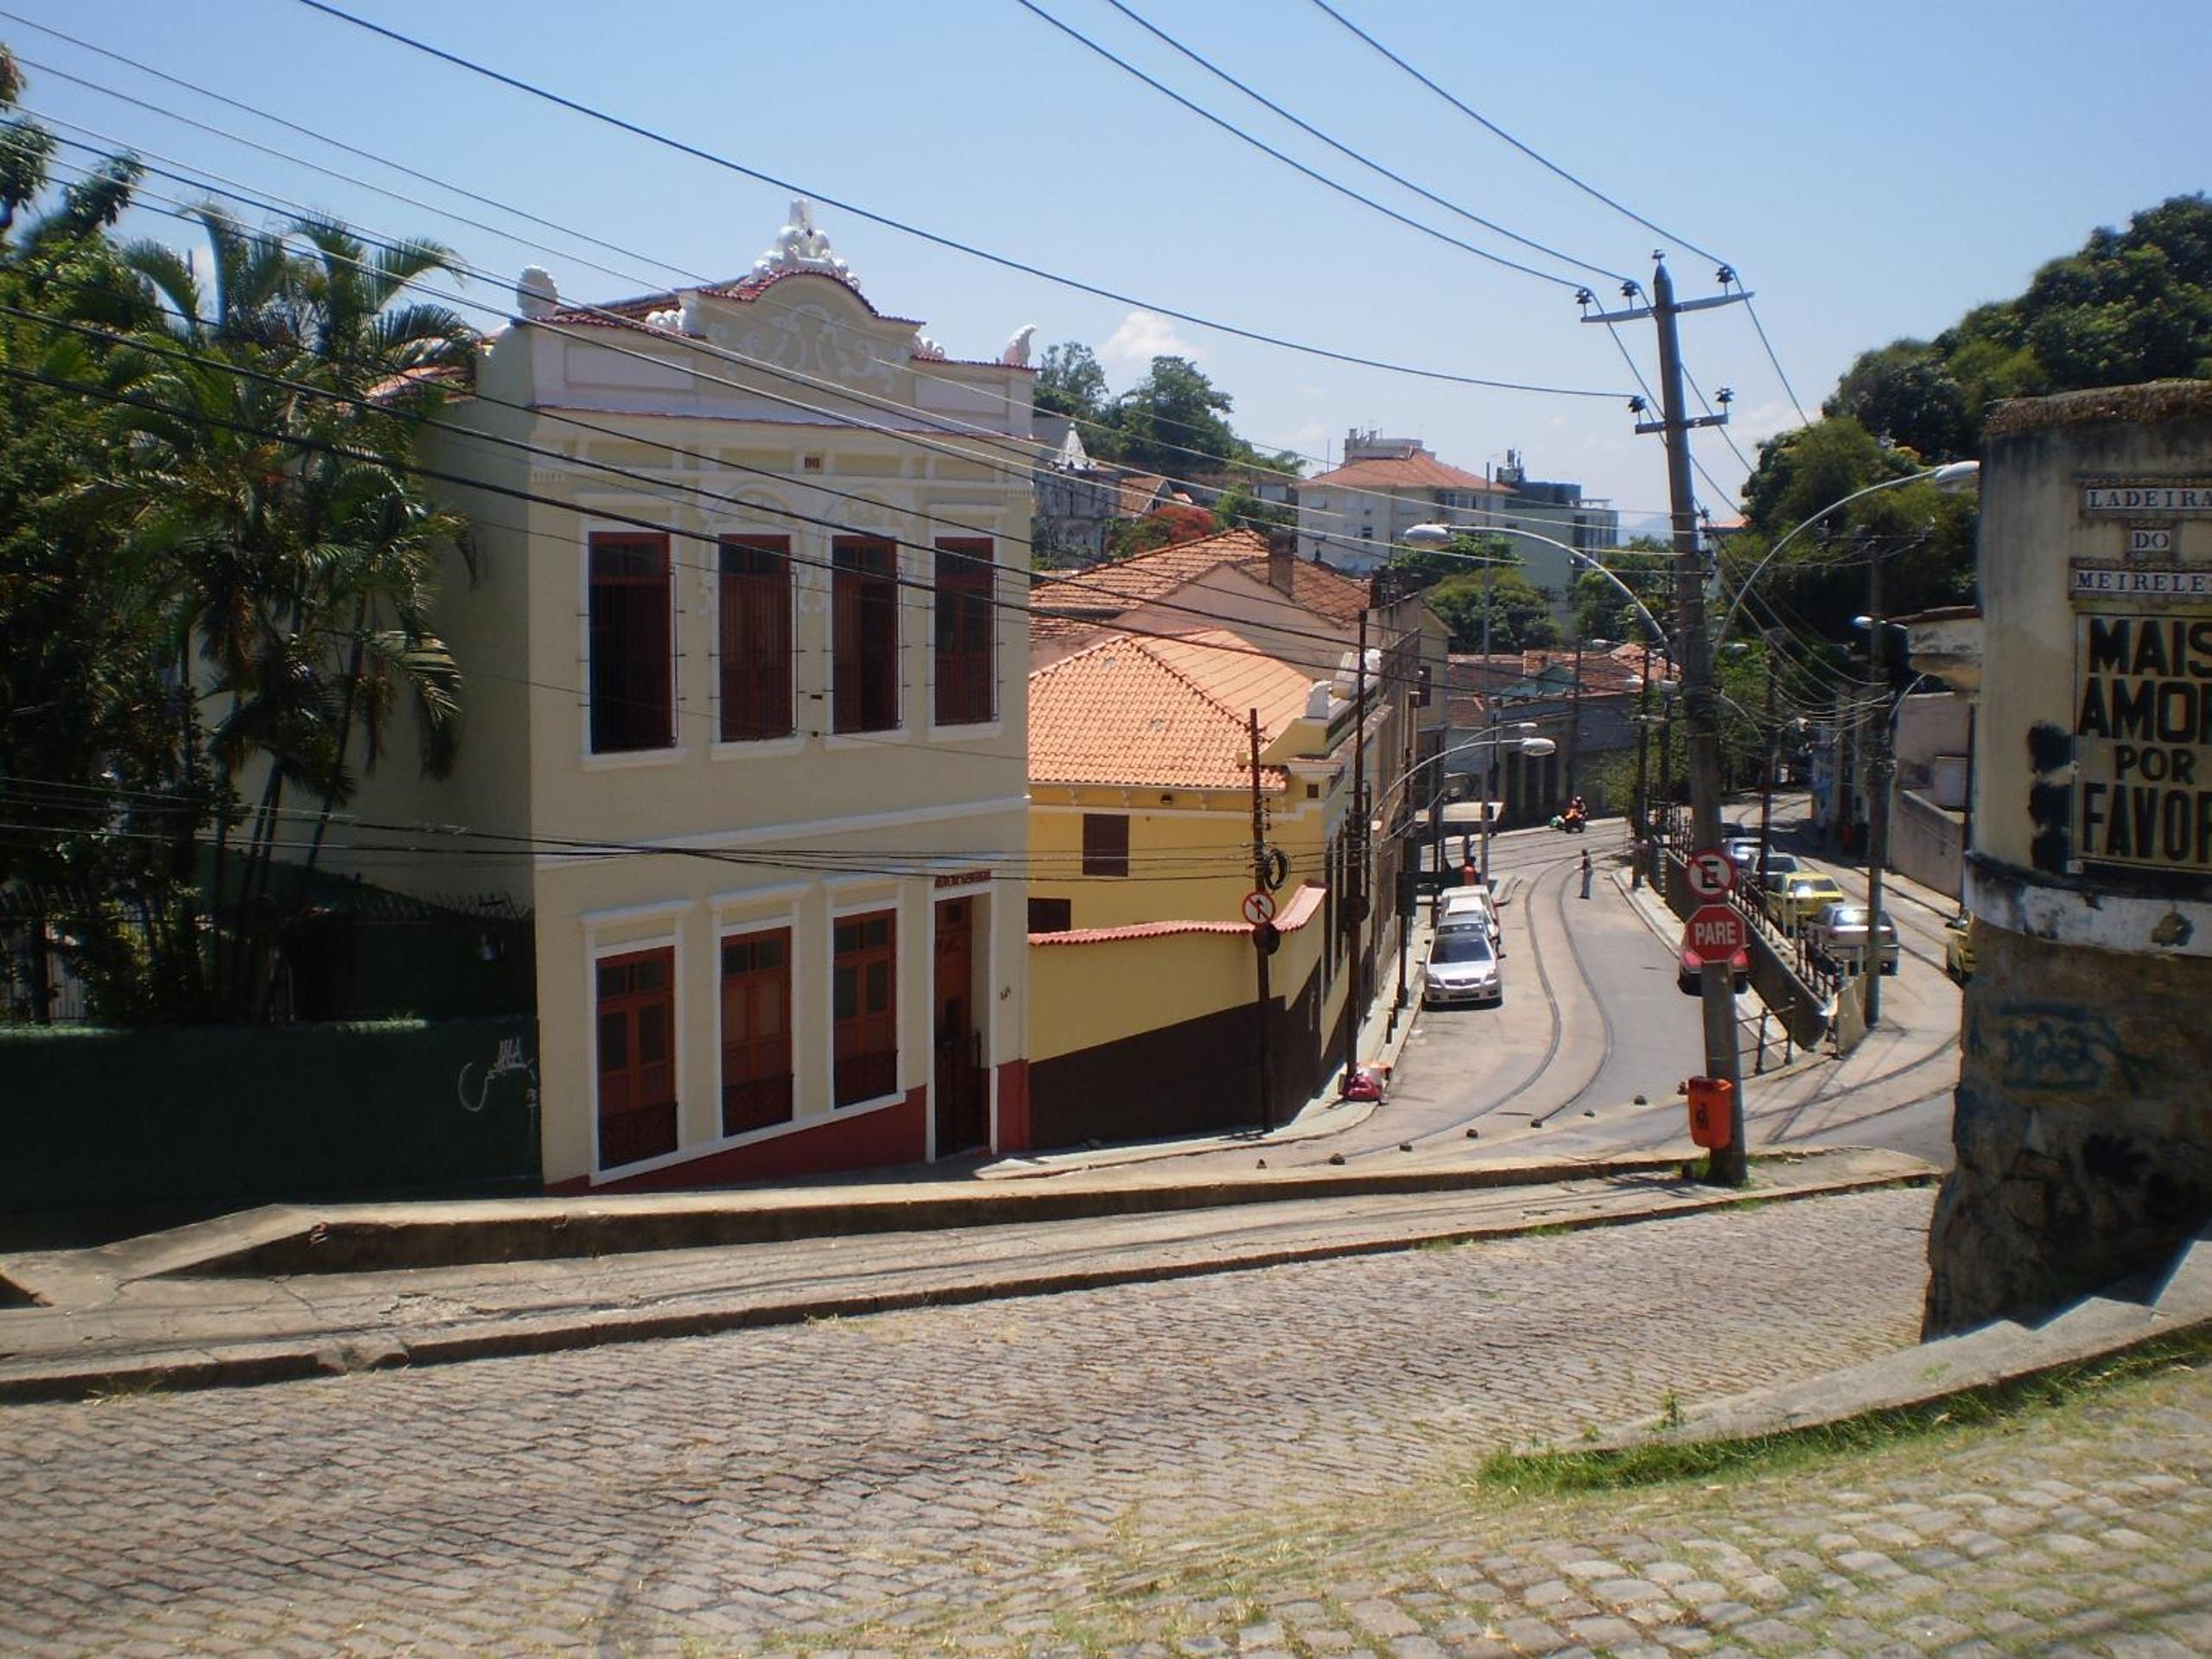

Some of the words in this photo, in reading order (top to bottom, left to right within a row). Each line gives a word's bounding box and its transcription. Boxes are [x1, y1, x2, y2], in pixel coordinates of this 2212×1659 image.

[2089, 490, 2212, 507] LADEIRA
[2134, 531, 2169, 549] DO
[2076, 572, 2212, 593] MEIRELE
[2089, 618, 2212, 678] MAIS
[2115, 744, 2195, 785] POR
[1701, 861, 1719, 888] E
[1694, 921, 1737, 946] PARE
